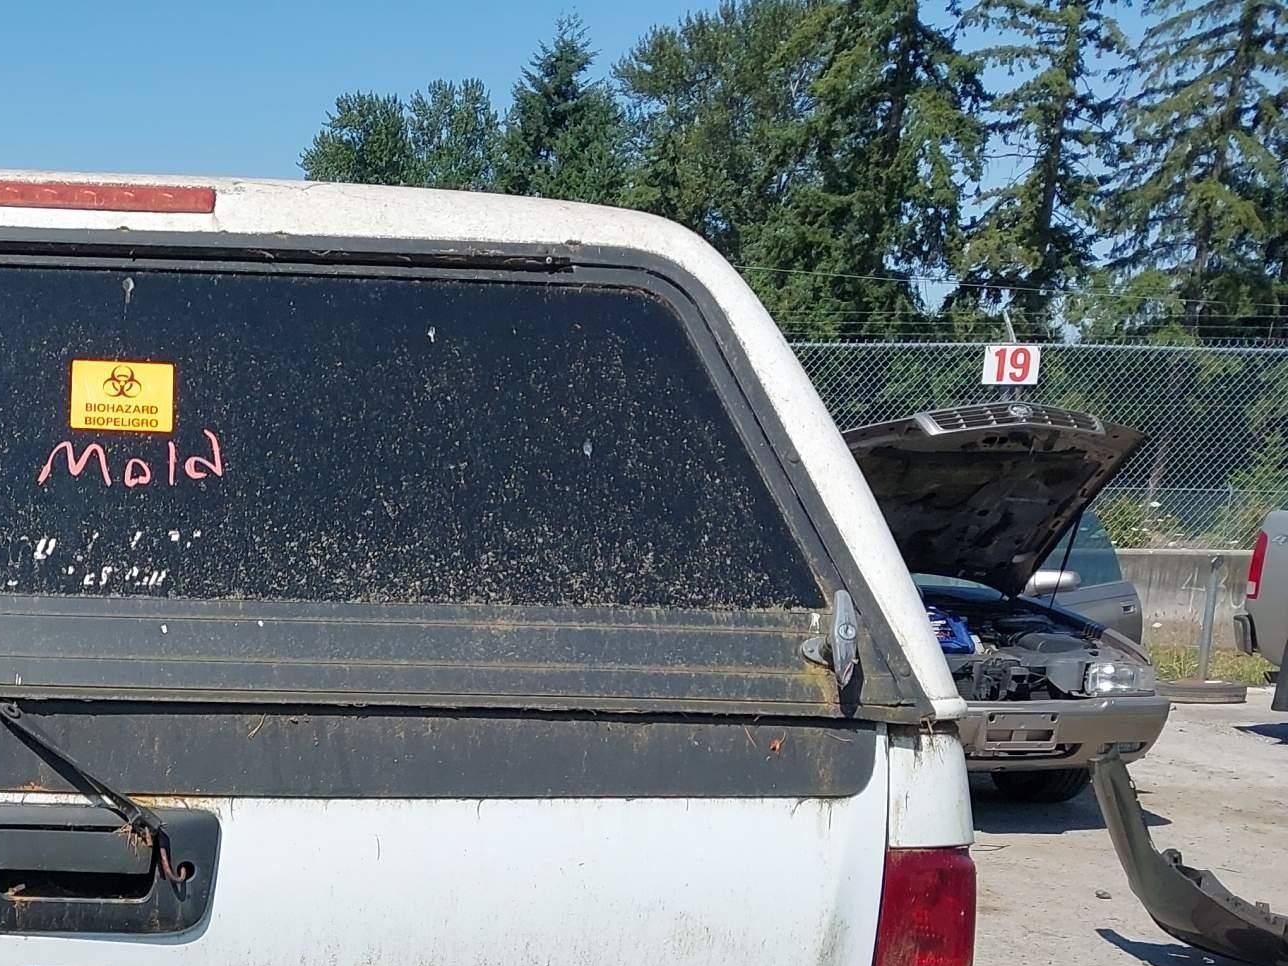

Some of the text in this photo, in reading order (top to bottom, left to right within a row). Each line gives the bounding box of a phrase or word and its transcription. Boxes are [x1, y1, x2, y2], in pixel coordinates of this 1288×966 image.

[994, 347, 1032, 382] 19
[85, 402, 159, 415] BIOHAZARD
[84, 416, 159, 428] BIOPELIGRO
[37, 429, 223, 487] Mold
